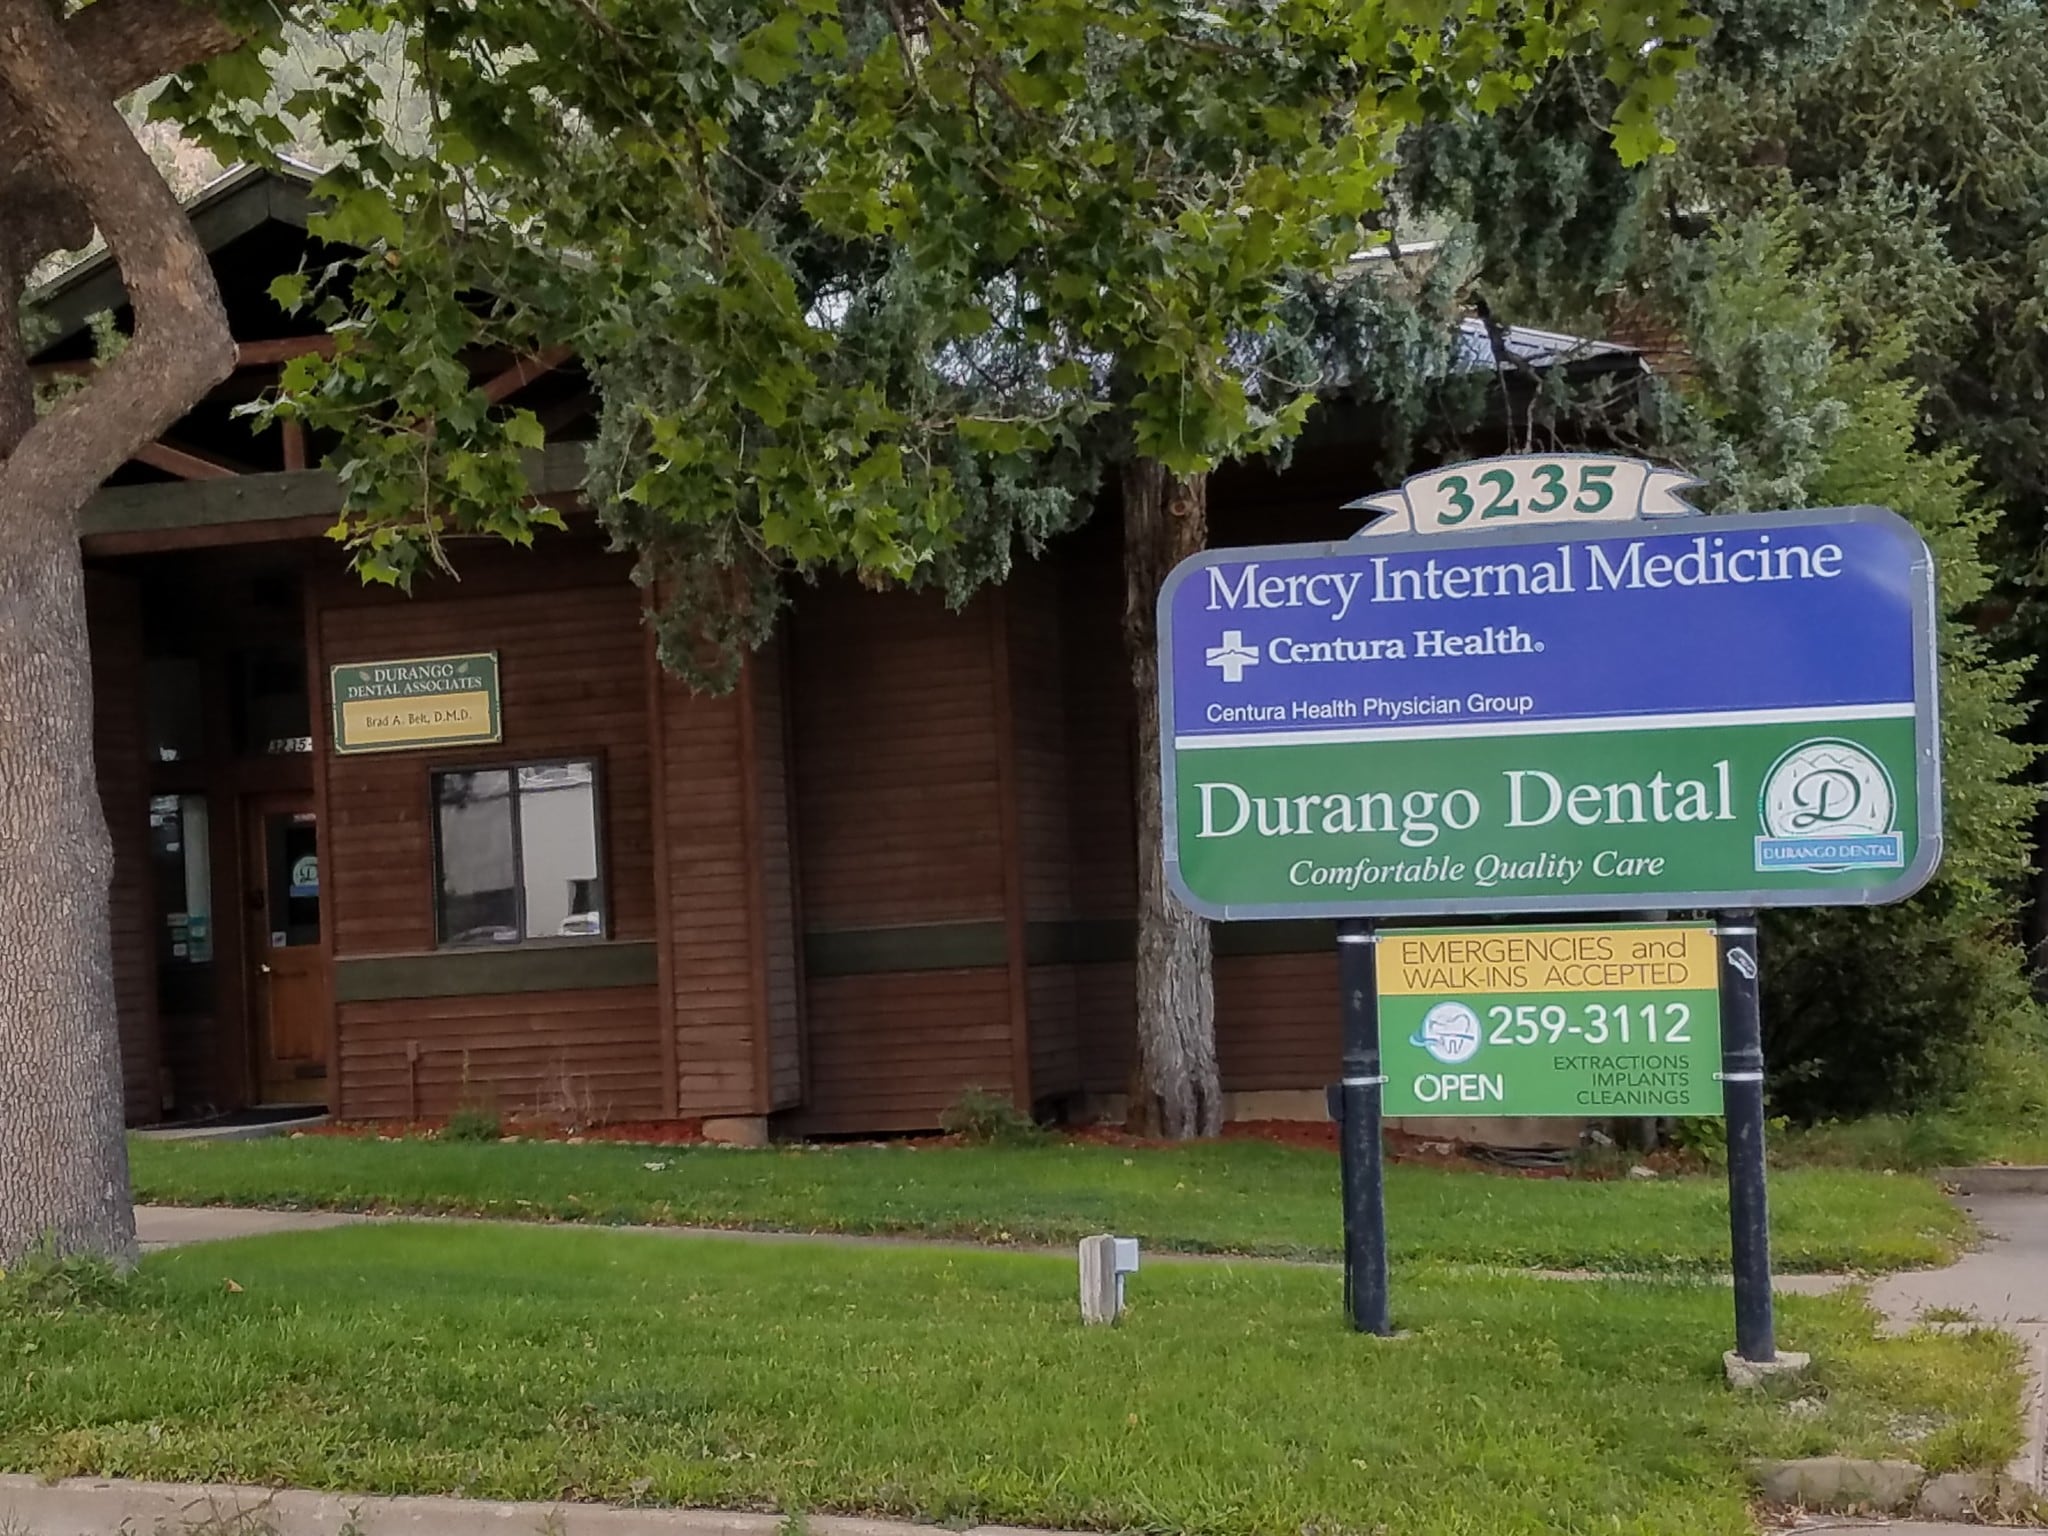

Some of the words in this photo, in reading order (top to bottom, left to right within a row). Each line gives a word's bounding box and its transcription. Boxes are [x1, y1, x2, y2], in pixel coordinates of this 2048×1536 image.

[1436, 463, 1616, 526] 3235
[1204, 563, 1362, 620] Mercy
[1369, 545, 1576, 603] Internal
[1585, 535, 1842, 592] Medicine
[1269, 637, 1406, 664] Centura
[374, 664, 454, 682] DURANGO
[348, 684, 400, 698] DENTAL
[404, 677, 482, 694] ASSOCIATES
[366, 715, 389, 728] Brad
[434, 708, 473, 723] D.M.D.
[1206, 703, 1286, 723] Centura
[1292, 699, 1356, 719] Health
[1364, 694, 1460, 720] Physician
[1467, 692, 1534, 716] Group
[1193, 782, 1480, 847] Durango
[1502, 760, 1737, 828] Dental
[1763, 846, 1836, 860] DURANGO
[1839, 844, 1896, 857] DENTAL
[1289, 856, 1465, 890] Comfortable
[1473, 851, 1583, 887] Quality
[1592, 850, 1666, 877] Care
[1402, 937, 1613, 965] EMERGENCIES
[1632, 933, 1687, 959] and
[1403, 966, 1528, 989] WALK-INS
[1544, 963, 1688, 986] ACCEPTED
[1488, 1003, 1691, 1045] 259-3112
[1554, 1055, 1690, 1070] EXTRACTIONS
[1414, 1073, 1504, 1102] OPEN
[1592, 1072, 1690, 1087] IMPLANTS
[1577, 1090, 1690, 1106] CLEANINGS
